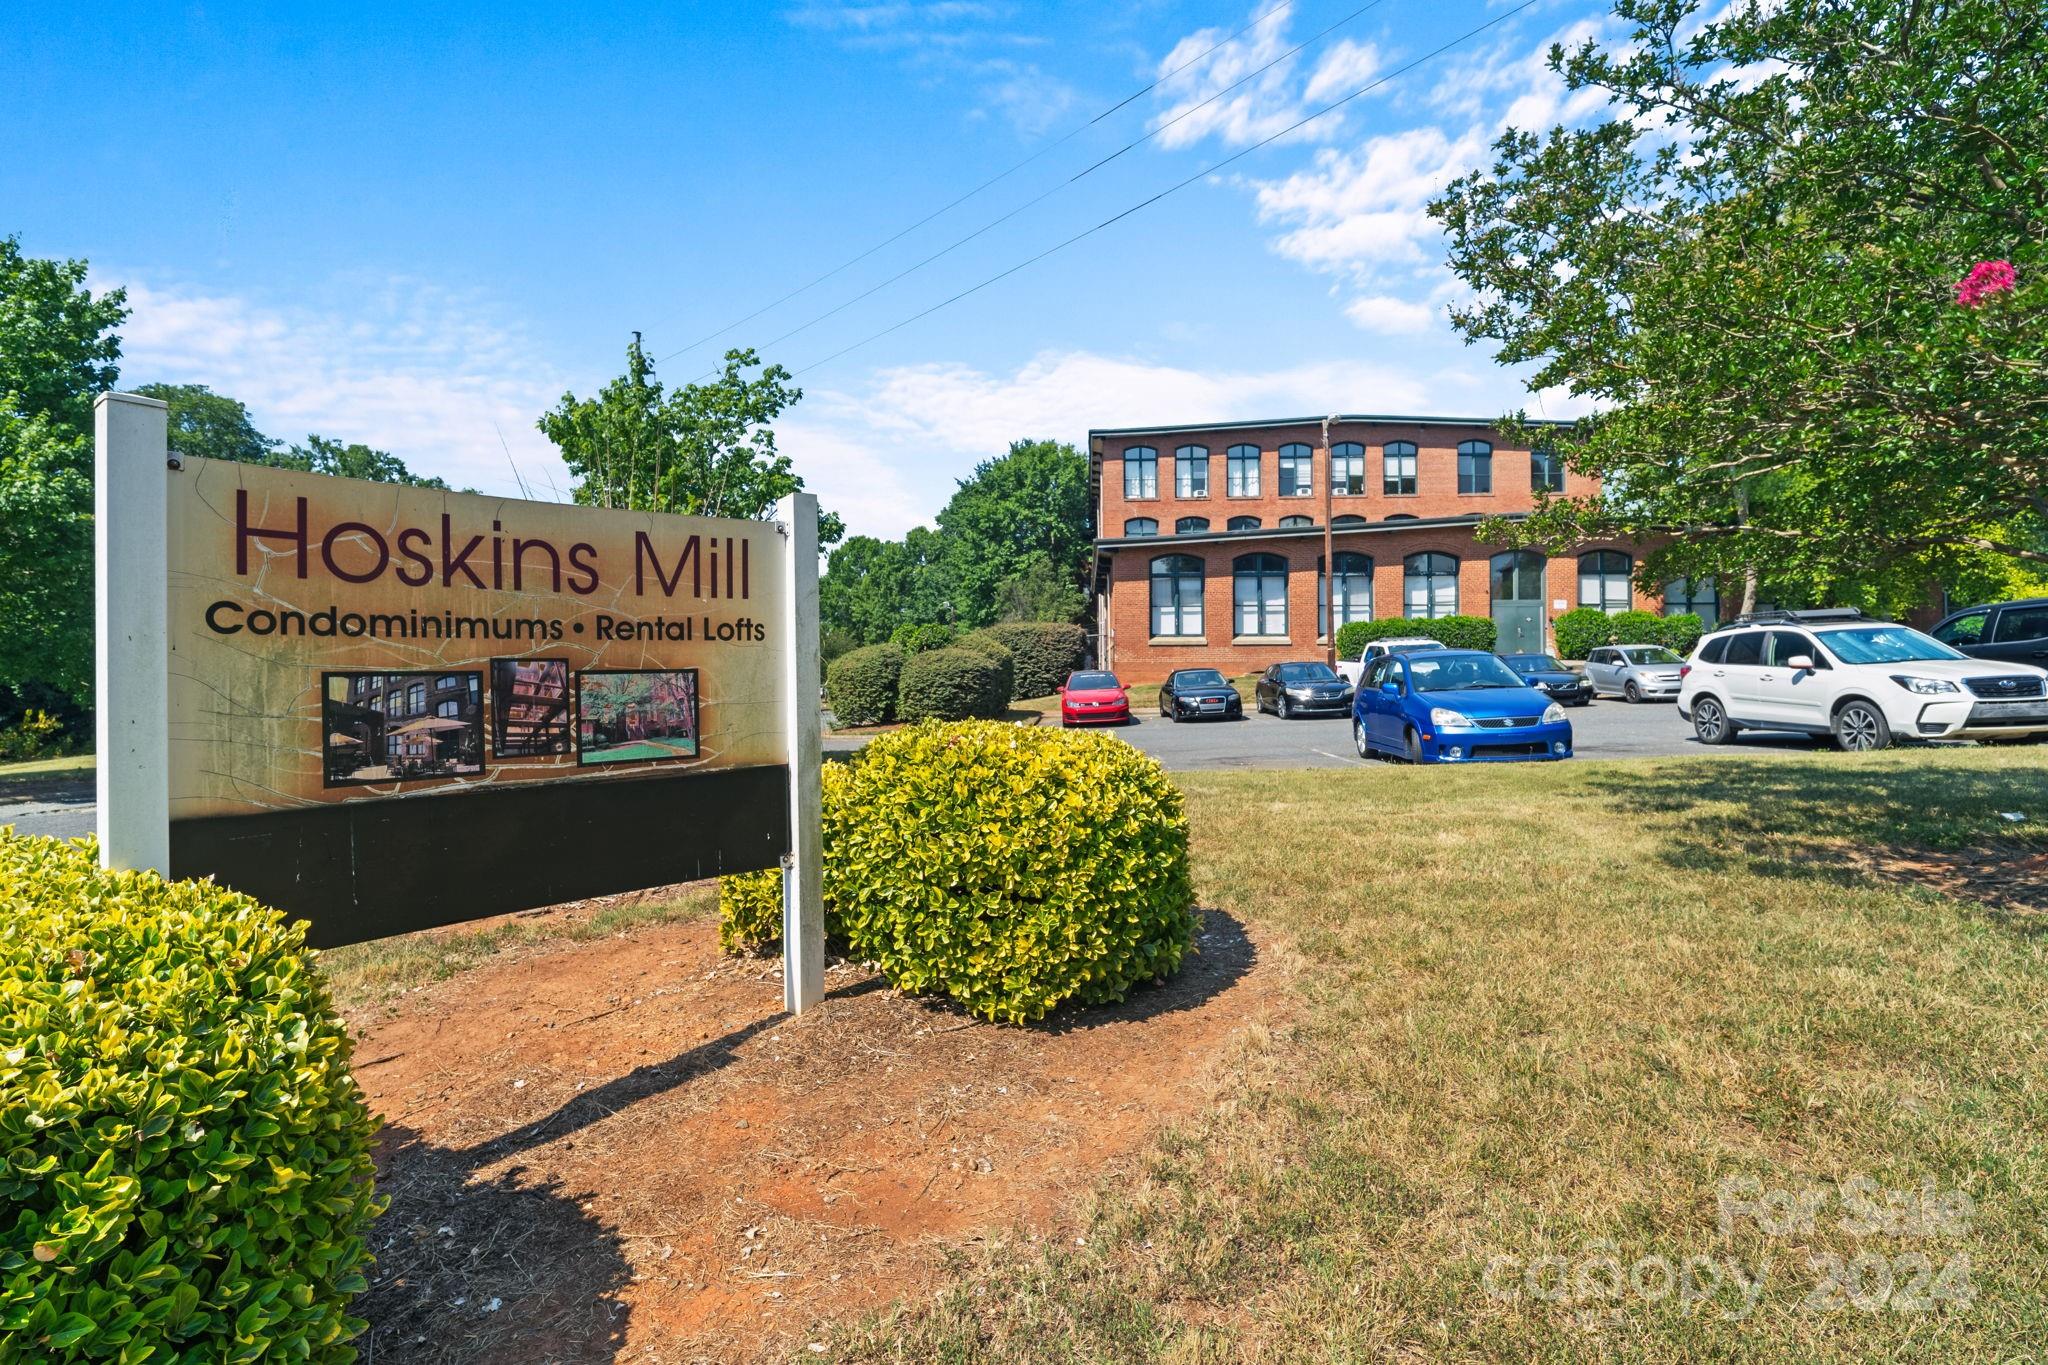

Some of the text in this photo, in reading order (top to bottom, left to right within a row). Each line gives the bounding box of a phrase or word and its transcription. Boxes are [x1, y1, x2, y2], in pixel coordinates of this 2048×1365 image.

[236, 489, 750, 600] Hoskins Mill
[205, 601, 766, 642] Condominimums Rental Lofts
